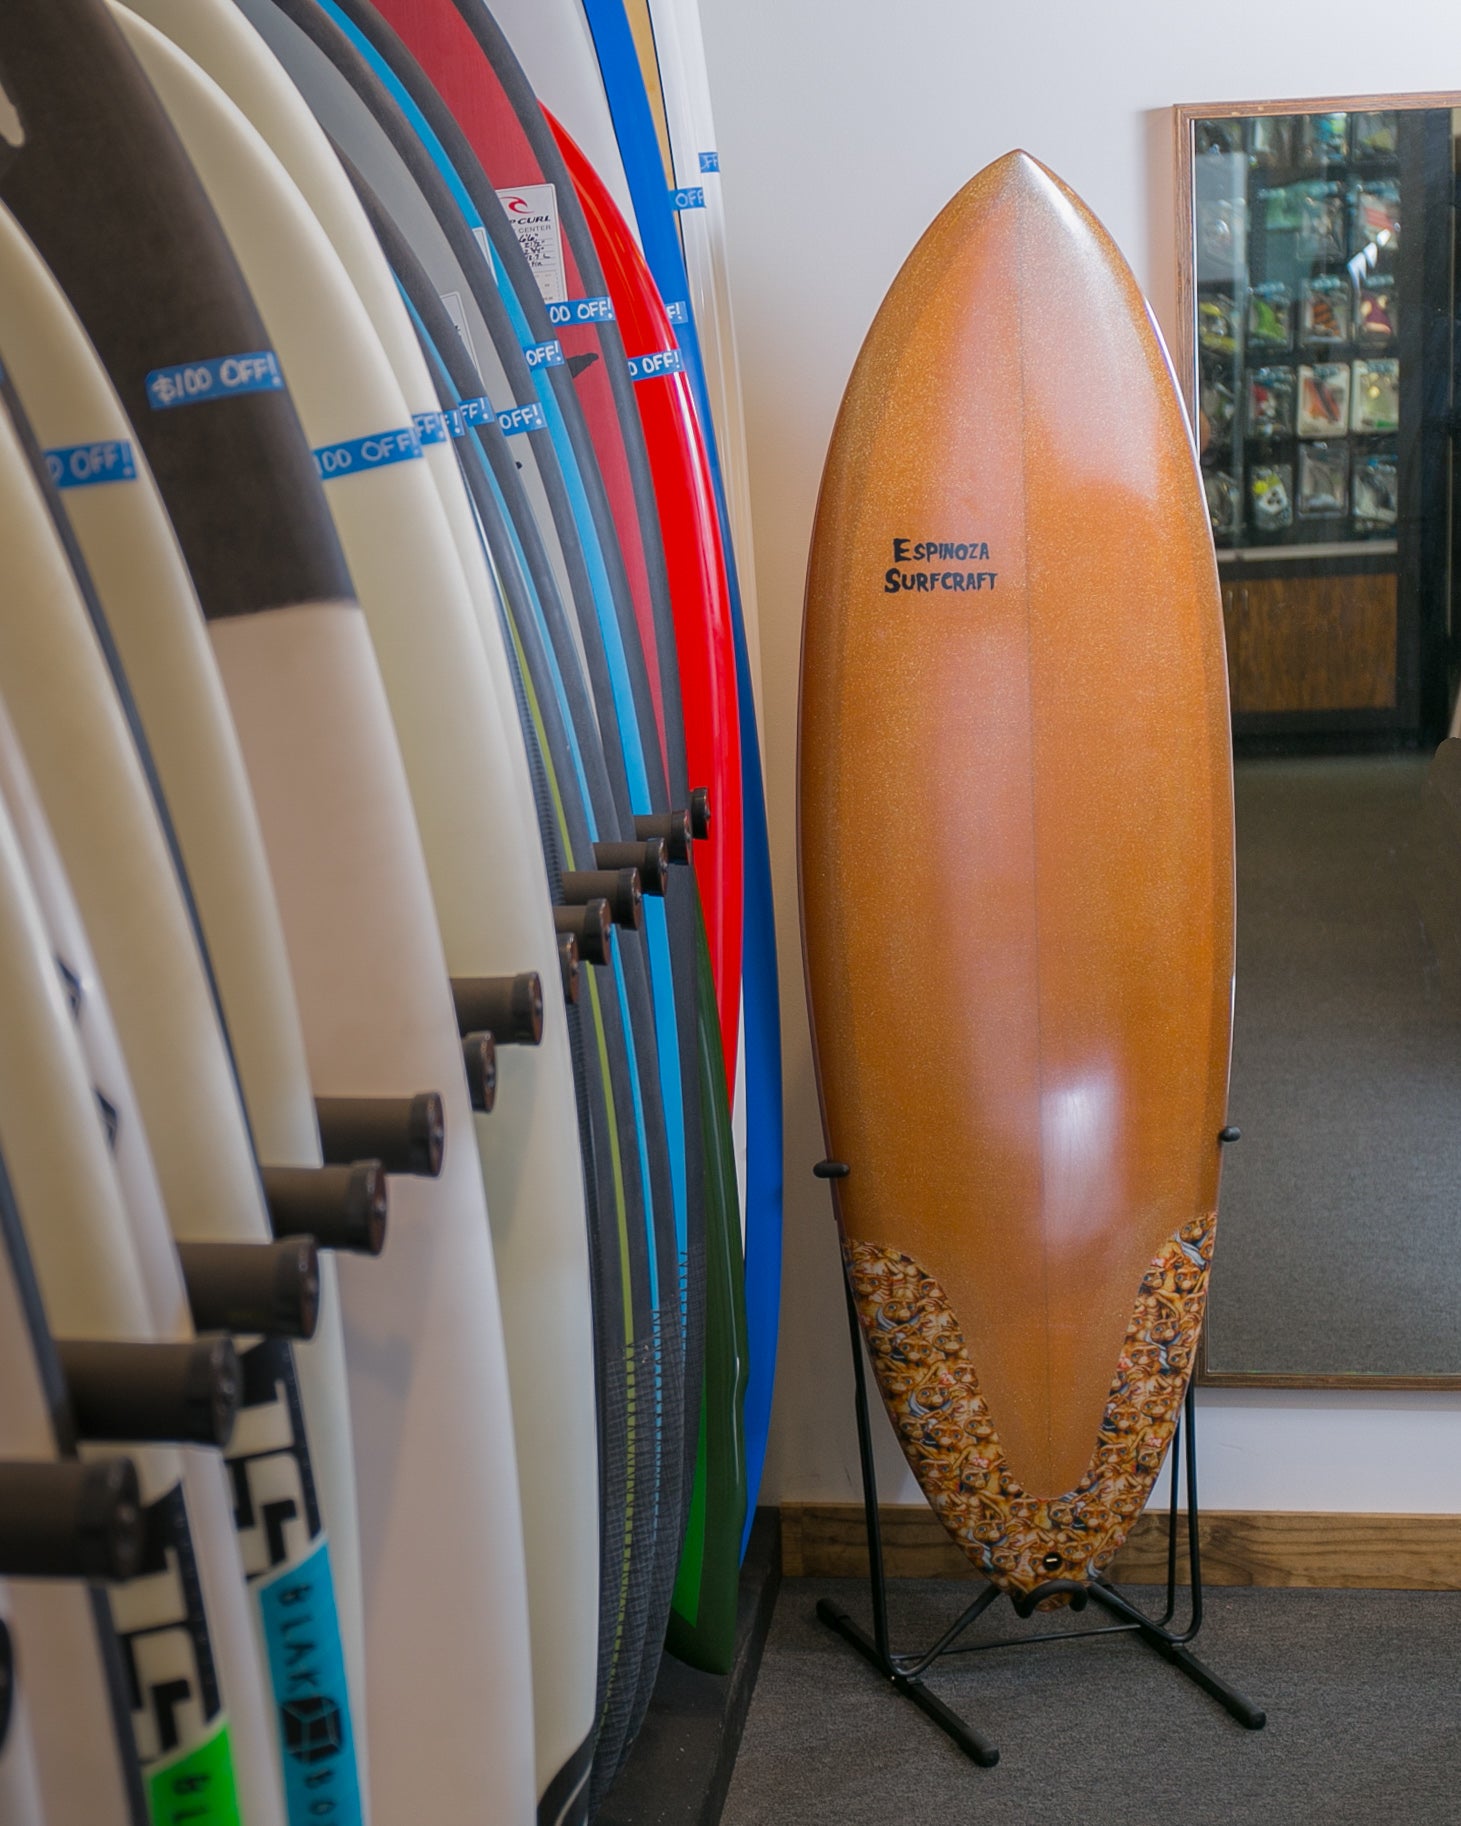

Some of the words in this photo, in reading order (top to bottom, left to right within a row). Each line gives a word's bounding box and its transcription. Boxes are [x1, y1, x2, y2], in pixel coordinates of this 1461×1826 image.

[517, 214, 551, 225] CURL
[577, 300, 613, 320] OFF!
[525, 341, 561, 366] OFF!
[642, 351, 680, 374] OFF!
[152, 366, 213, 404] $100
[220, 353, 281, 387] OFF!
[499, 403, 542, 430] OFF!
[361, 428, 420, 461] OFF!
[70, 441, 133, 479] OFF!
[892, 537, 990, 563] ESPINOZA
[884, 567, 998, 594] SURFCRAFT
[304, 1768, 338, 1826] BO
